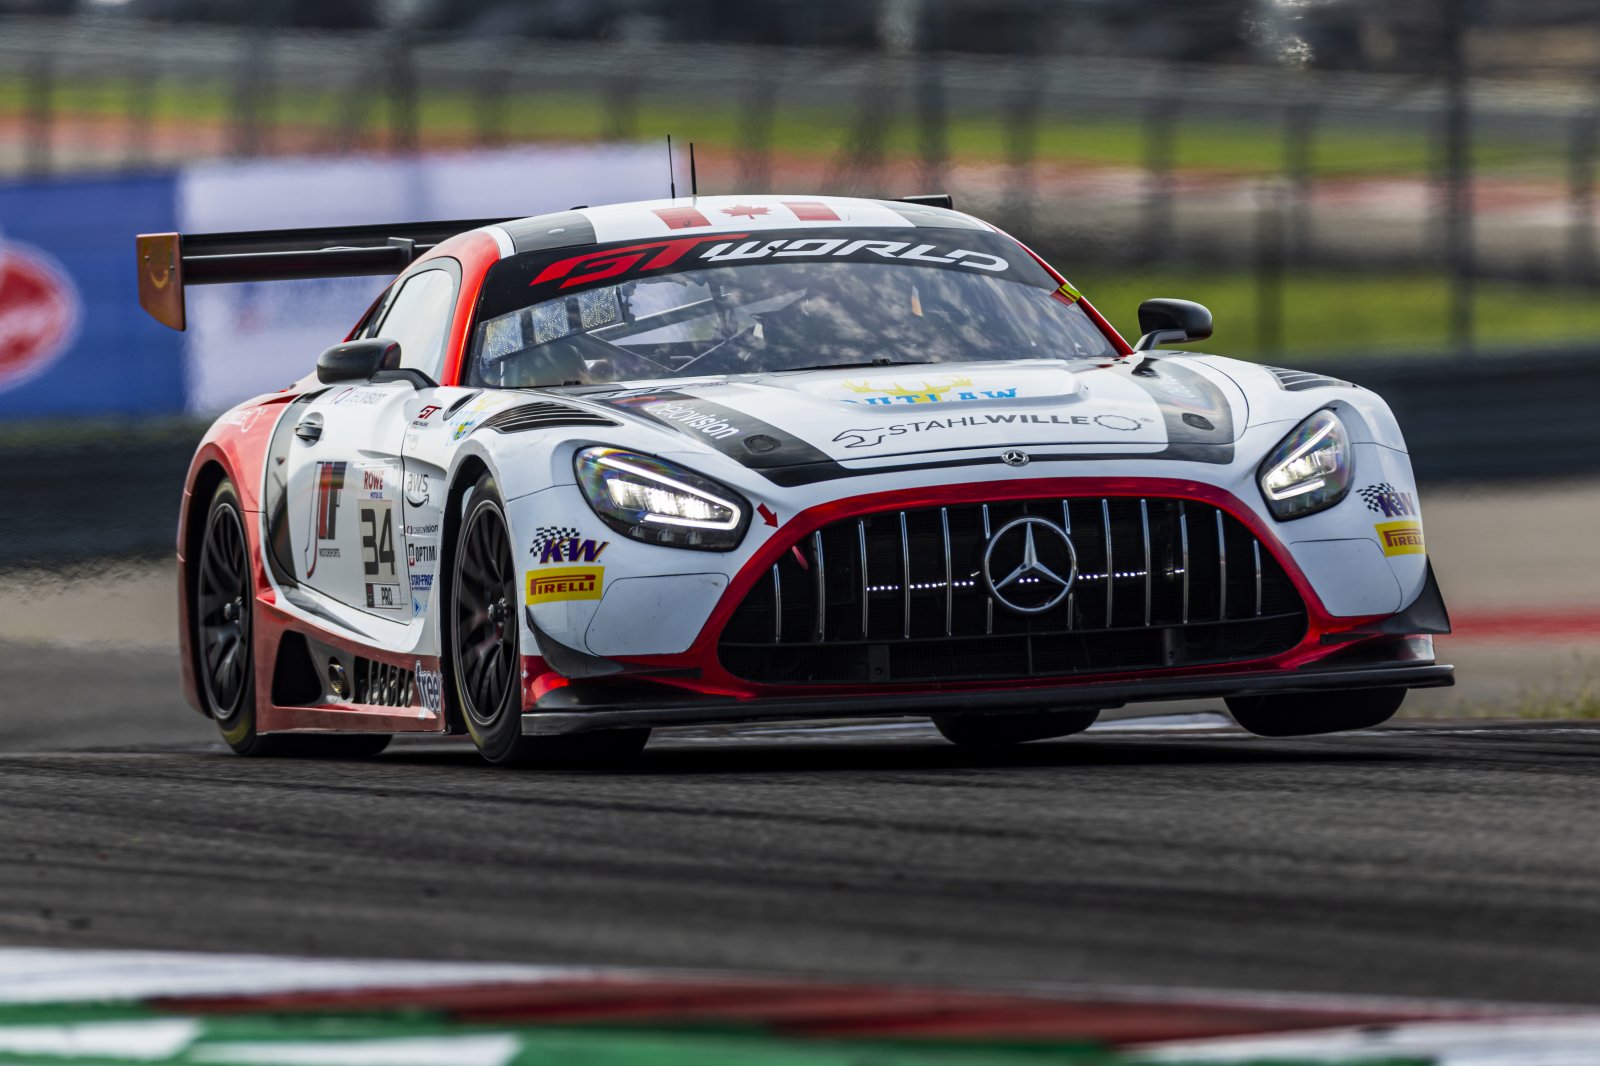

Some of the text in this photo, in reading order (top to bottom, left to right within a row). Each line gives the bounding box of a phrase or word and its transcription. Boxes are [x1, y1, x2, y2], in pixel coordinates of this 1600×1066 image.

[529, 234, 1009, 290] GT WORLD
[888, 414, 1090, 436] STAHLWILLE
[363, 470, 384, 490] ROWE
[407, 472, 429, 493] aws
[360, 508, 396, 576] 34
[539, 536, 610, 564] KW
[530, 574, 596, 596] PIRELLI
[380, 587, 394, 606] PRO
